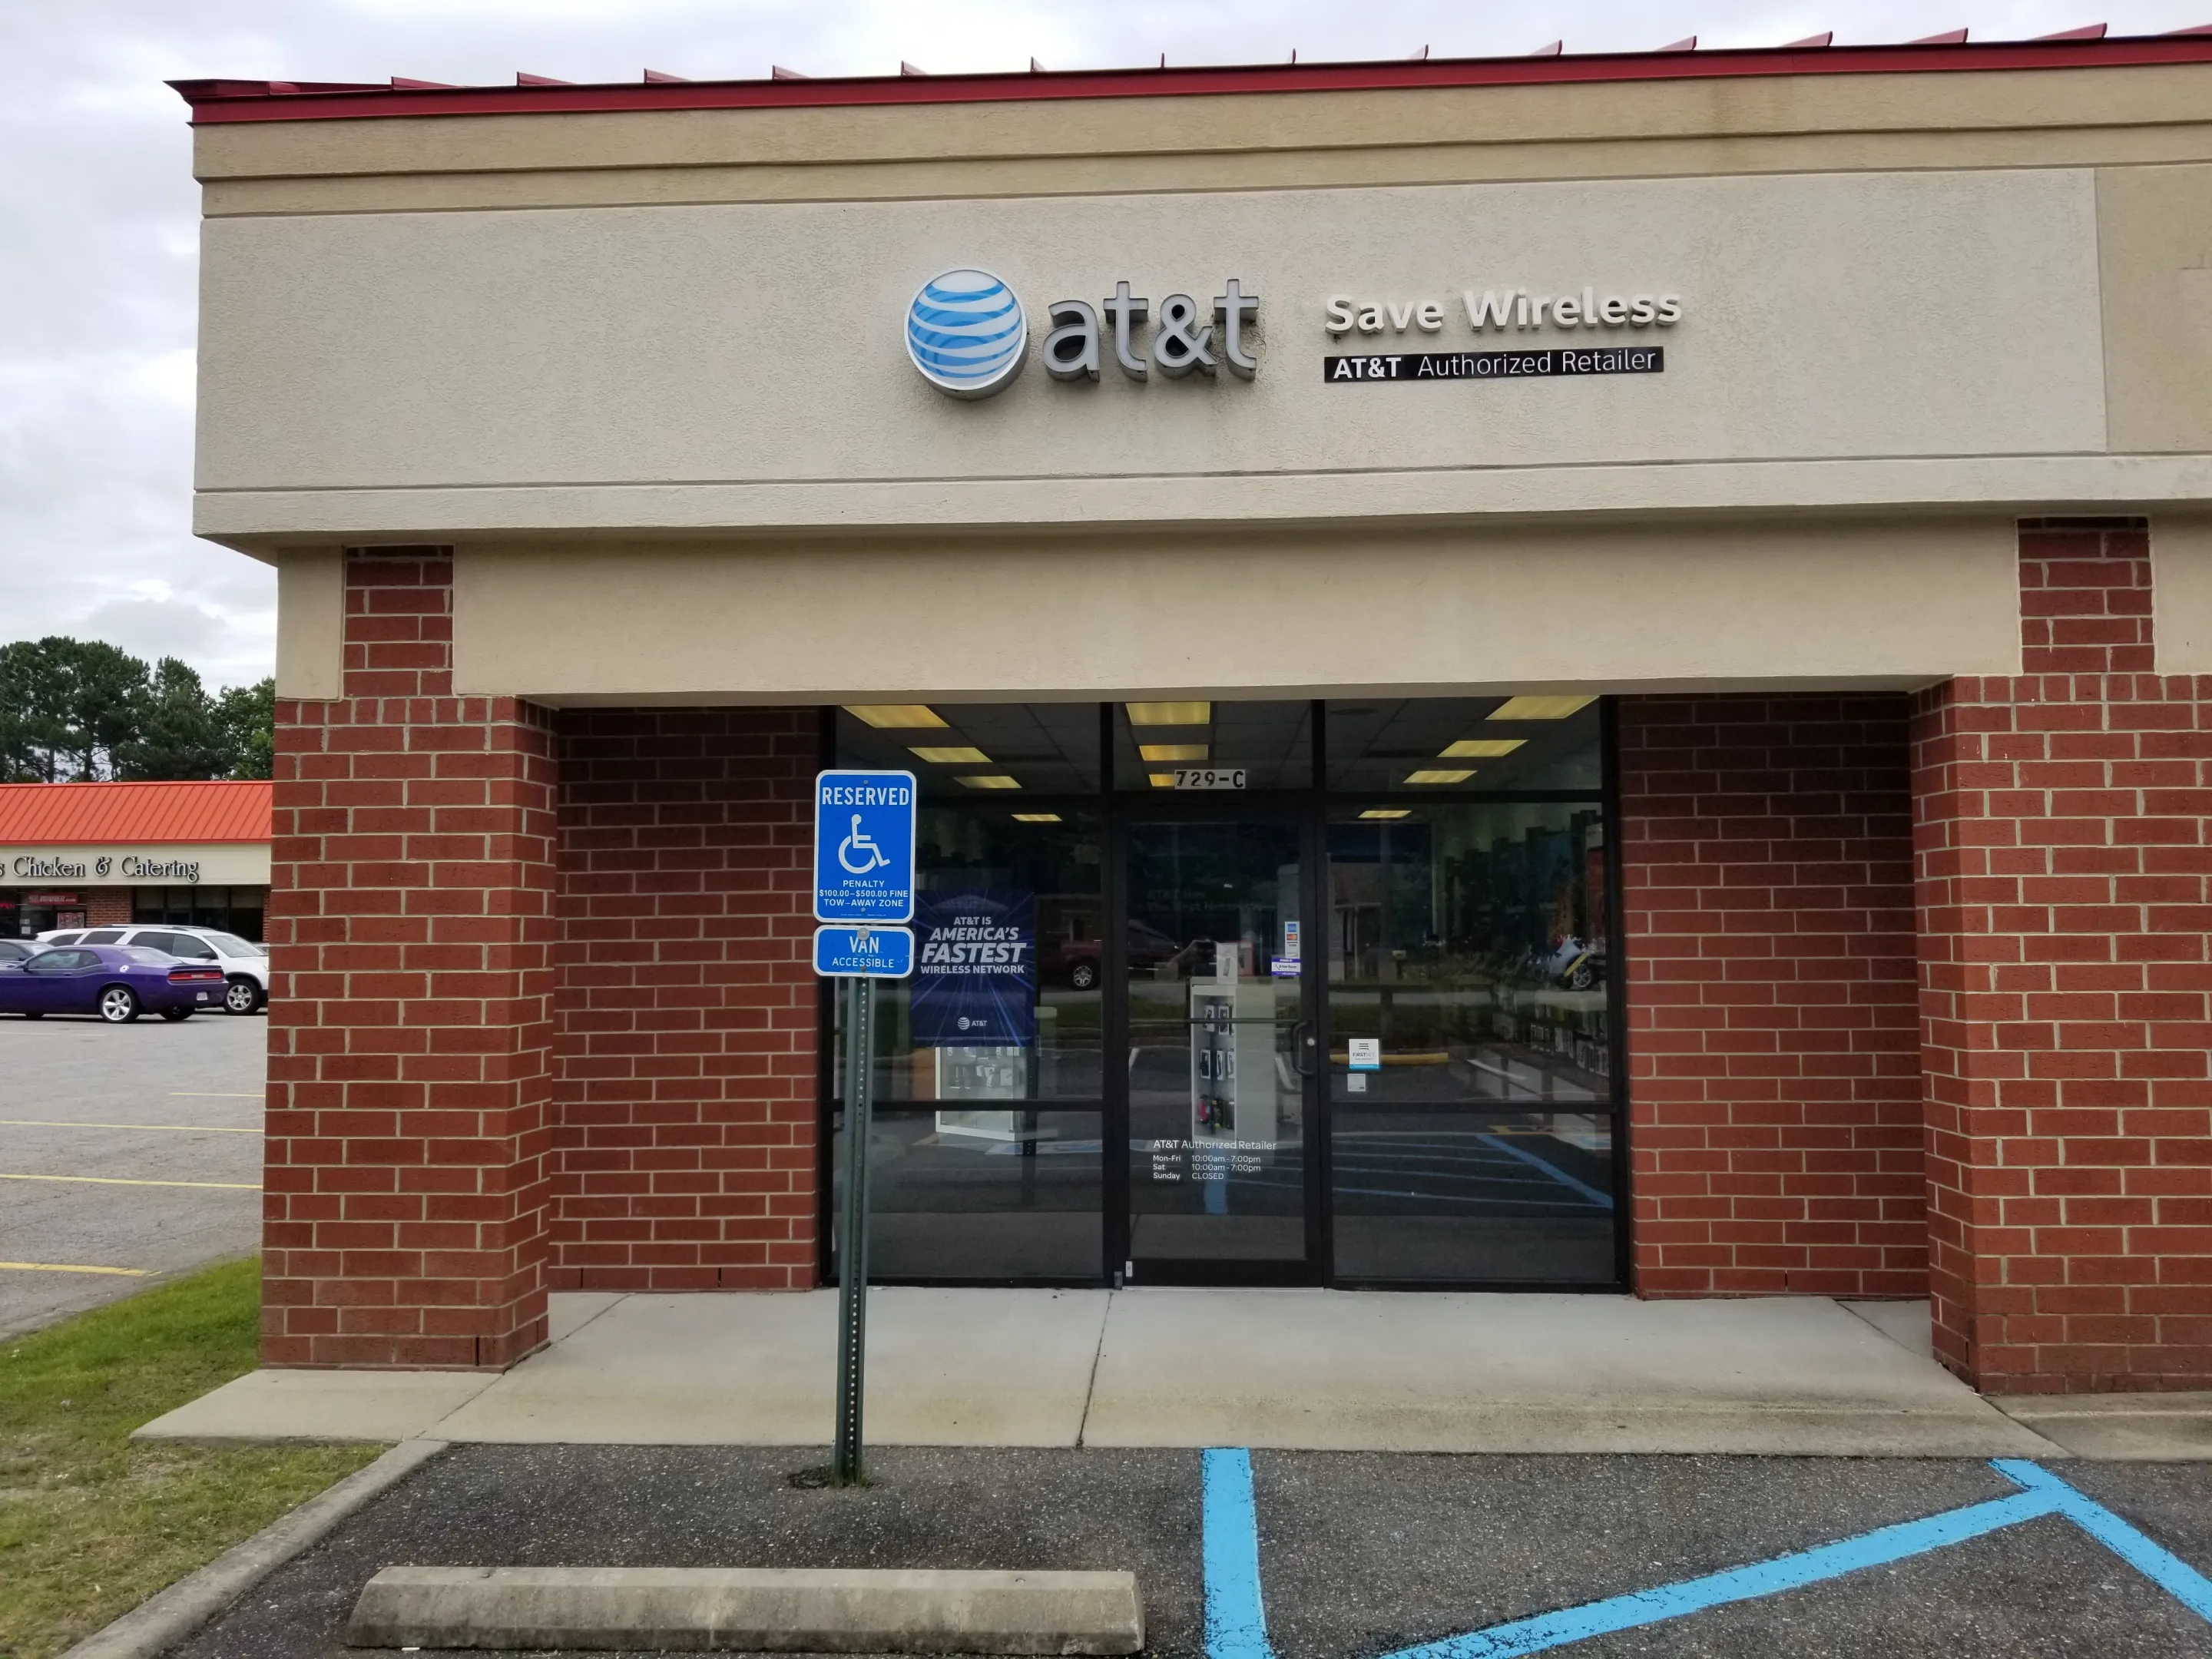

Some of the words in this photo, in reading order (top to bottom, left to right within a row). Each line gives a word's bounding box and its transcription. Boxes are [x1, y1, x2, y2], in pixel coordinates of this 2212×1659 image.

[1325, 293, 1445, 335] Save
[1462, 286, 1683, 330] Wireless
[1042, 278, 1259, 382] at&t
[1333, 356, 1402, 379] AT&T
[1418, 352, 1551, 377] Authorized
[1562, 349, 1656, 373] Retailer
[1176, 770, 1244, 788] 729-C
[822, 786, 909, 806] RESERVED
[12, 856, 85, 877] Chicken
[94, 856, 112, 876] &
[120, 856, 199, 882] Catering
[843, 879, 885, 888] PENALTY
[954, 916, 979, 926] AT&T
[982, 916, 992, 925] IS
[929, 927, 1019, 941] AMERICA'S
[849, 936, 879, 954] VAN
[922, 942, 1027, 963] FASTEST
[832, 957, 895, 968] ACCESSIBLE
[921, 965, 971, 974] WIRELESS
[972, 965, 1025, 974] NETWORK
[1153, 1140, 1179, 1149] AT&T
[1181, 1140, 1237, 1150] Authorized
[1238, 1141, 1277, 1150] Retailer
[1230, 1155, 1261, 1164] 7:00pm
[1230, 1164, 1261, 1173] 7:00pm
[1153, 1172, 1181, 1181] Sunday
